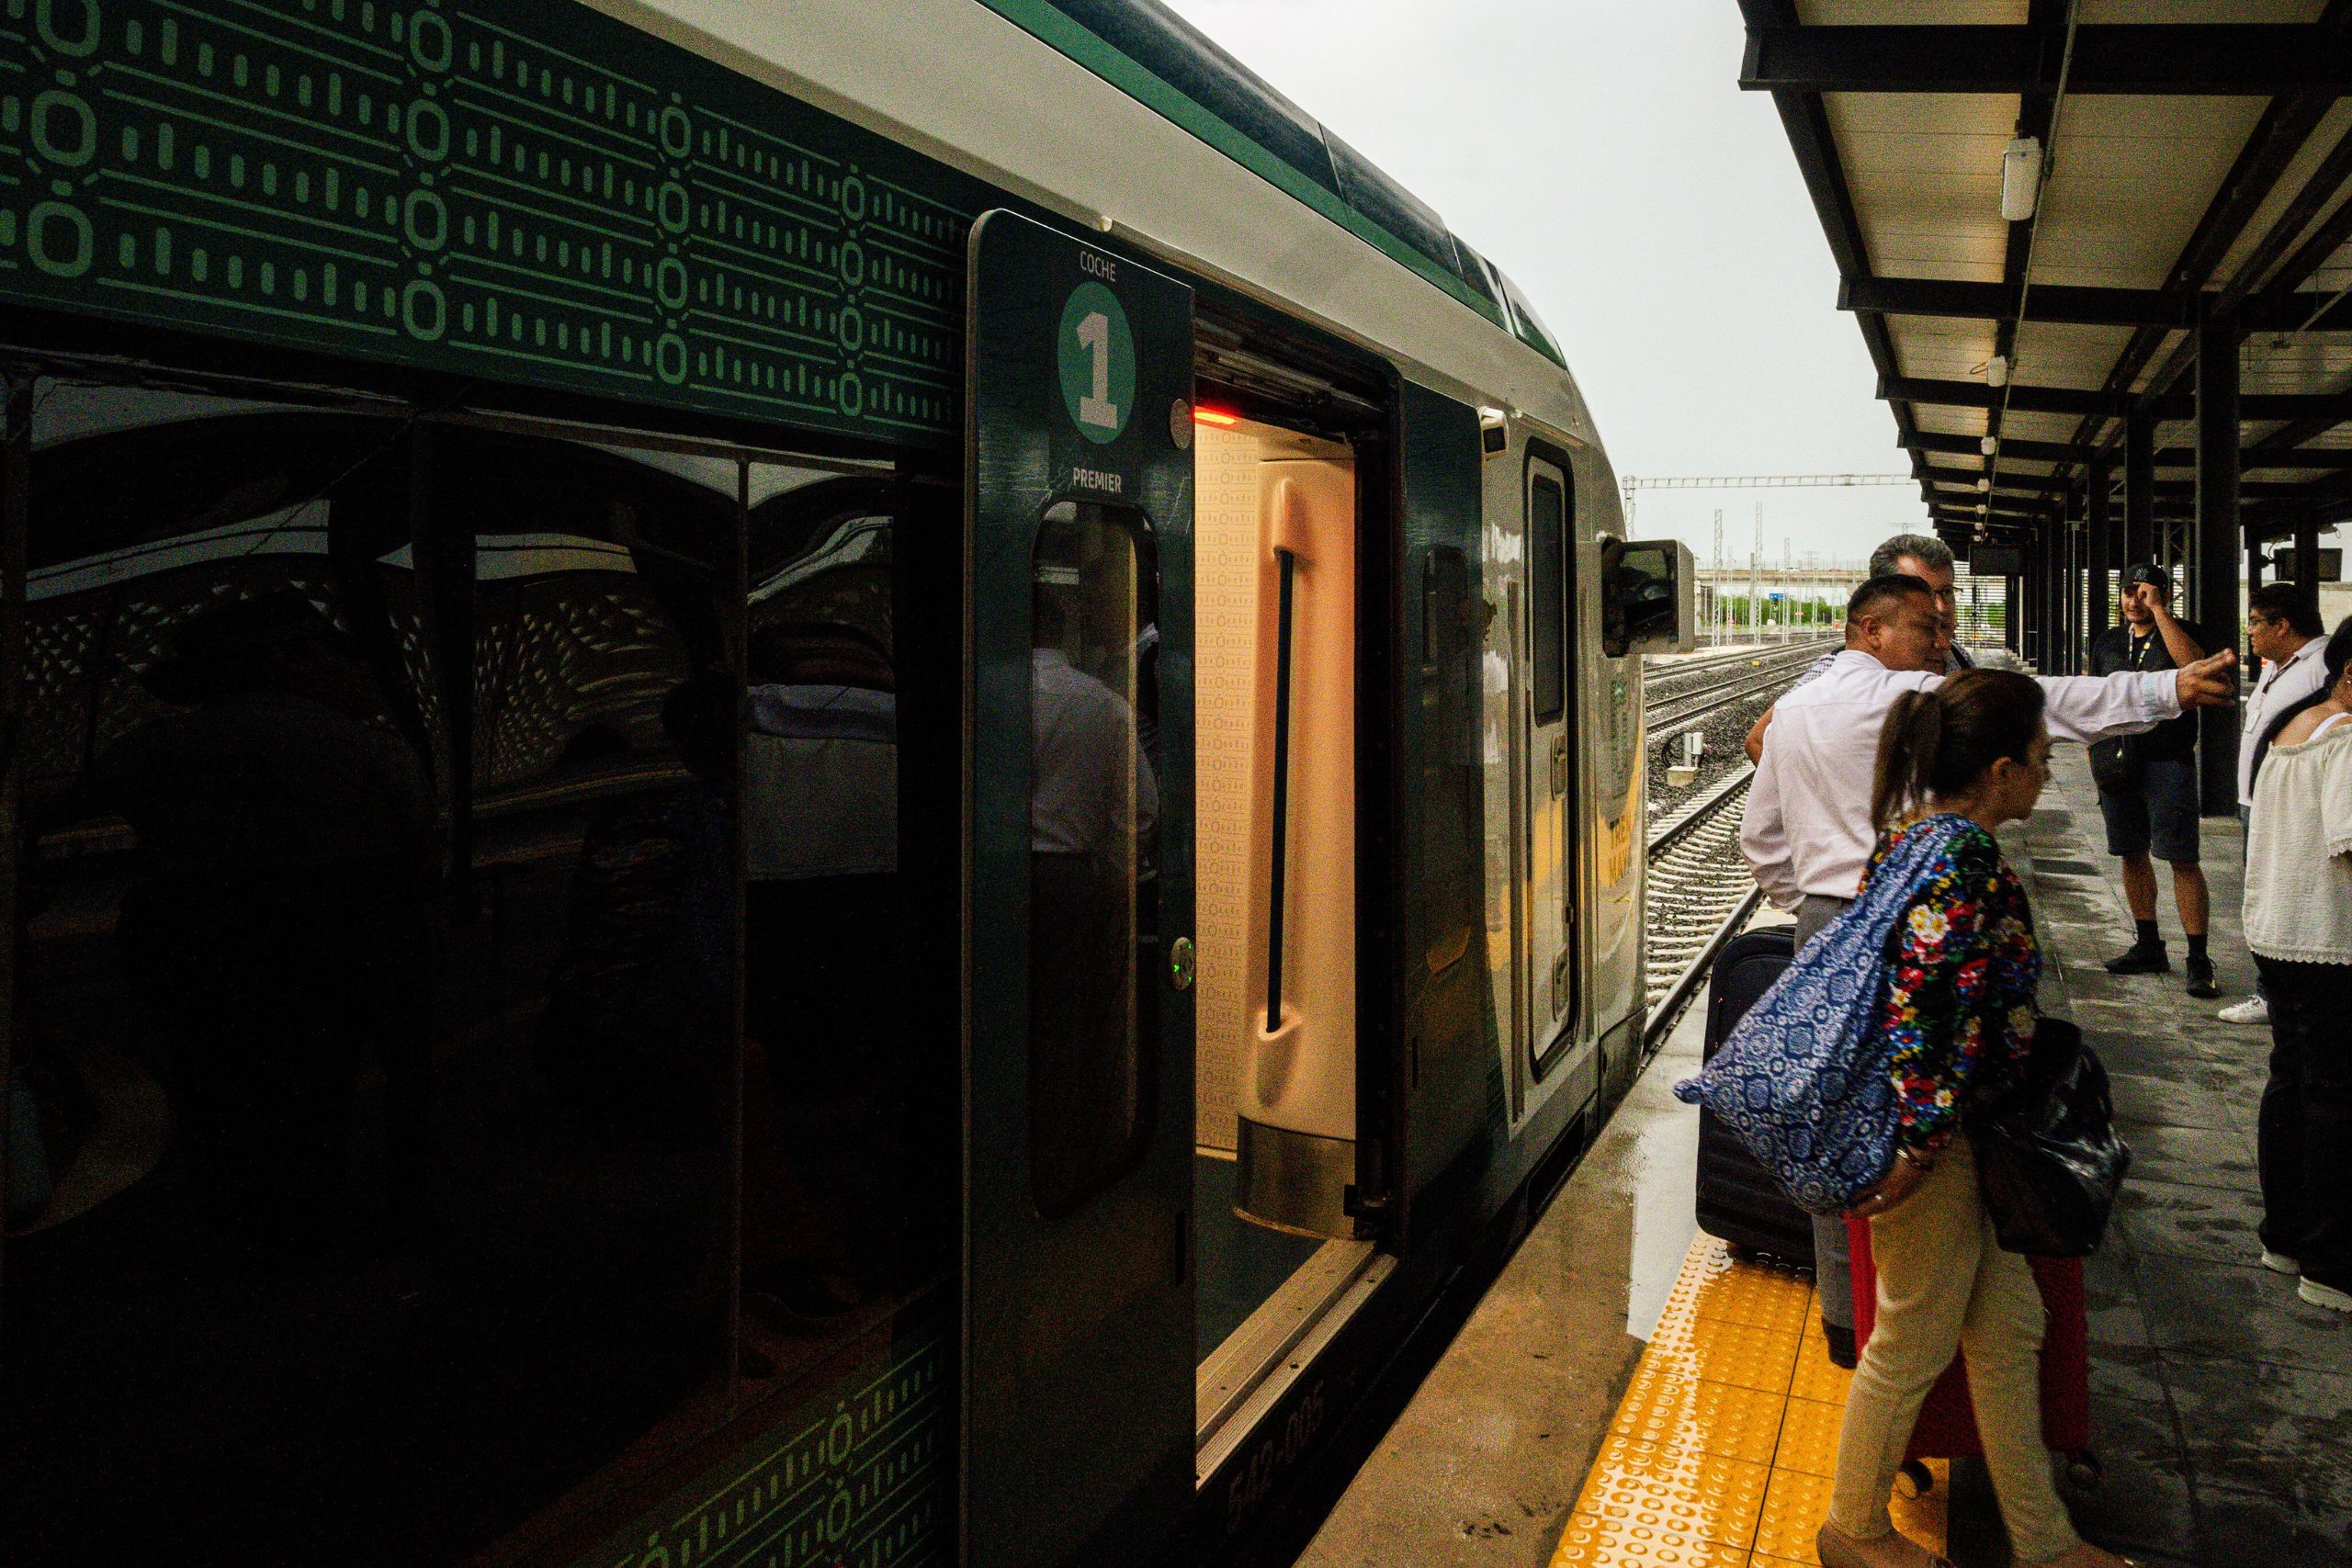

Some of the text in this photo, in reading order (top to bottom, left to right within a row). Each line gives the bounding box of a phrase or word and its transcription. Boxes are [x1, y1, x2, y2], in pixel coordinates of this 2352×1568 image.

[1080, 250, 1116, 283] COCHE
[1077, 311, 1118, 430] 1
[1073, 467, 1122, 494] PREMIER
